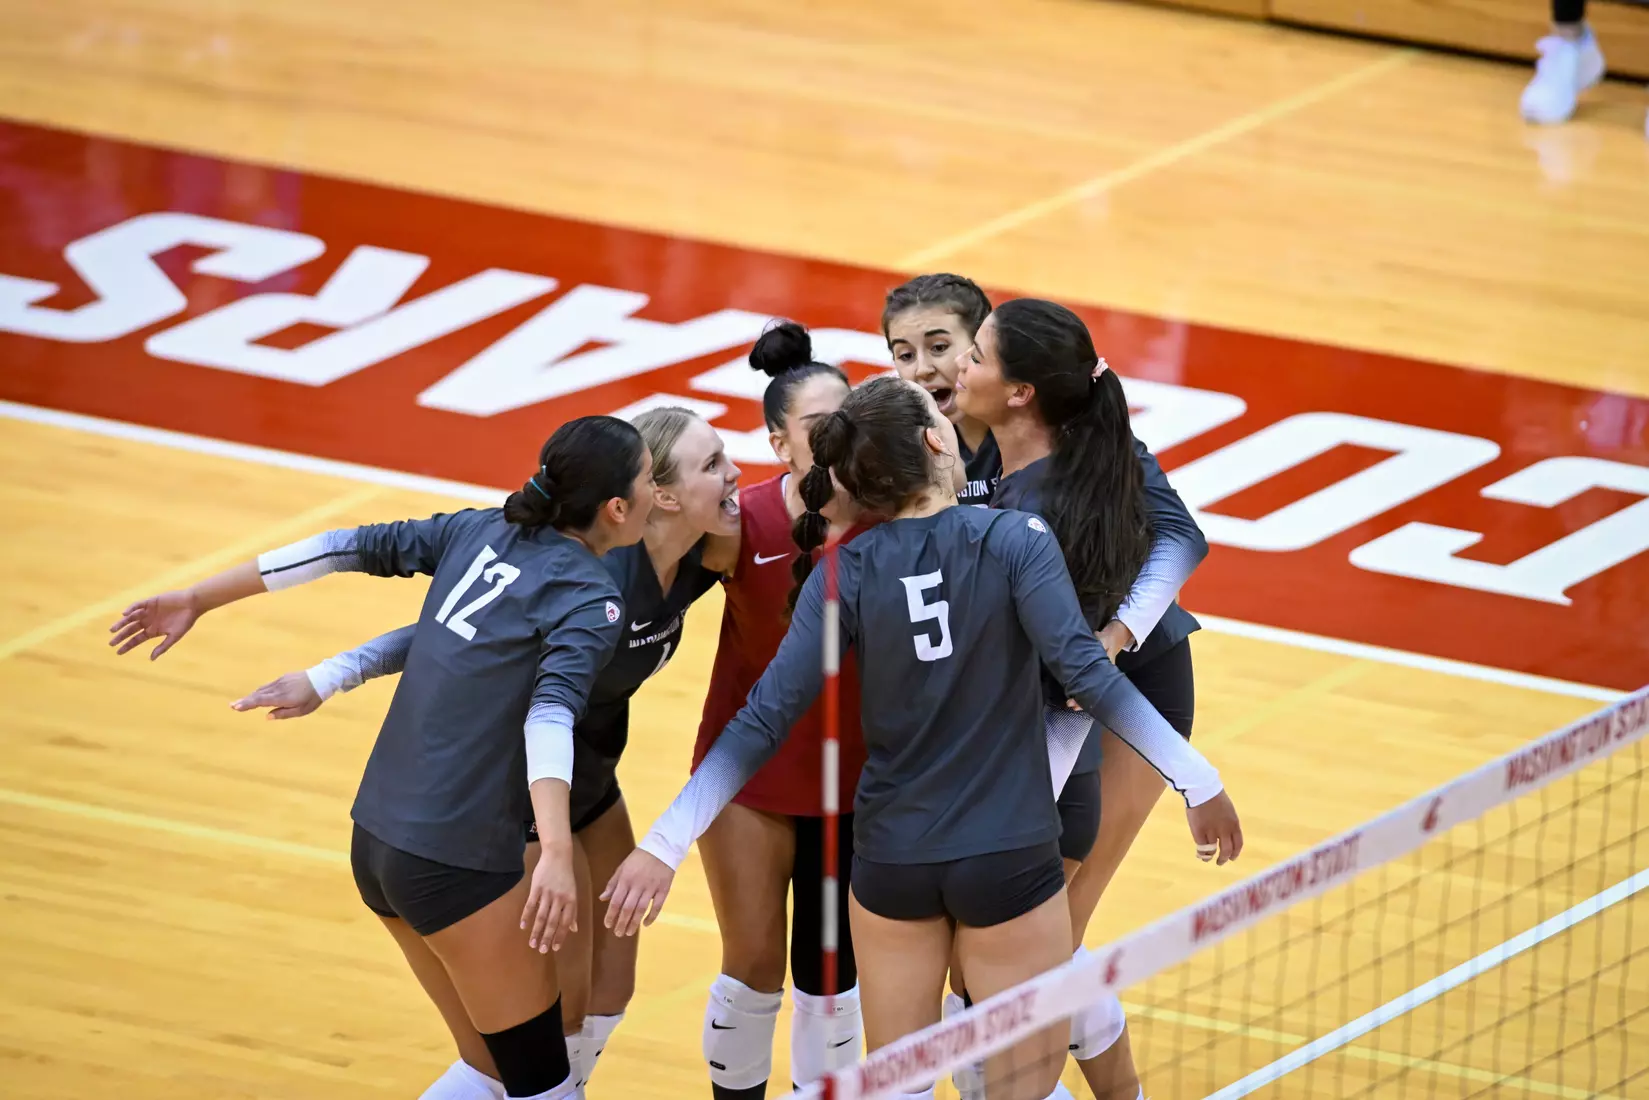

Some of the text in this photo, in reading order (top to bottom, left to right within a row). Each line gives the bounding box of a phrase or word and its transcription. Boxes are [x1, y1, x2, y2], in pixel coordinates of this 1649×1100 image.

[434, 544, 521, 642] 12
[898, 568, 954, 662] 5
[1504, 716, 1613, 790] WASHINGTON
[1190, 830, 1364, 944] WASHINGTON STATE
